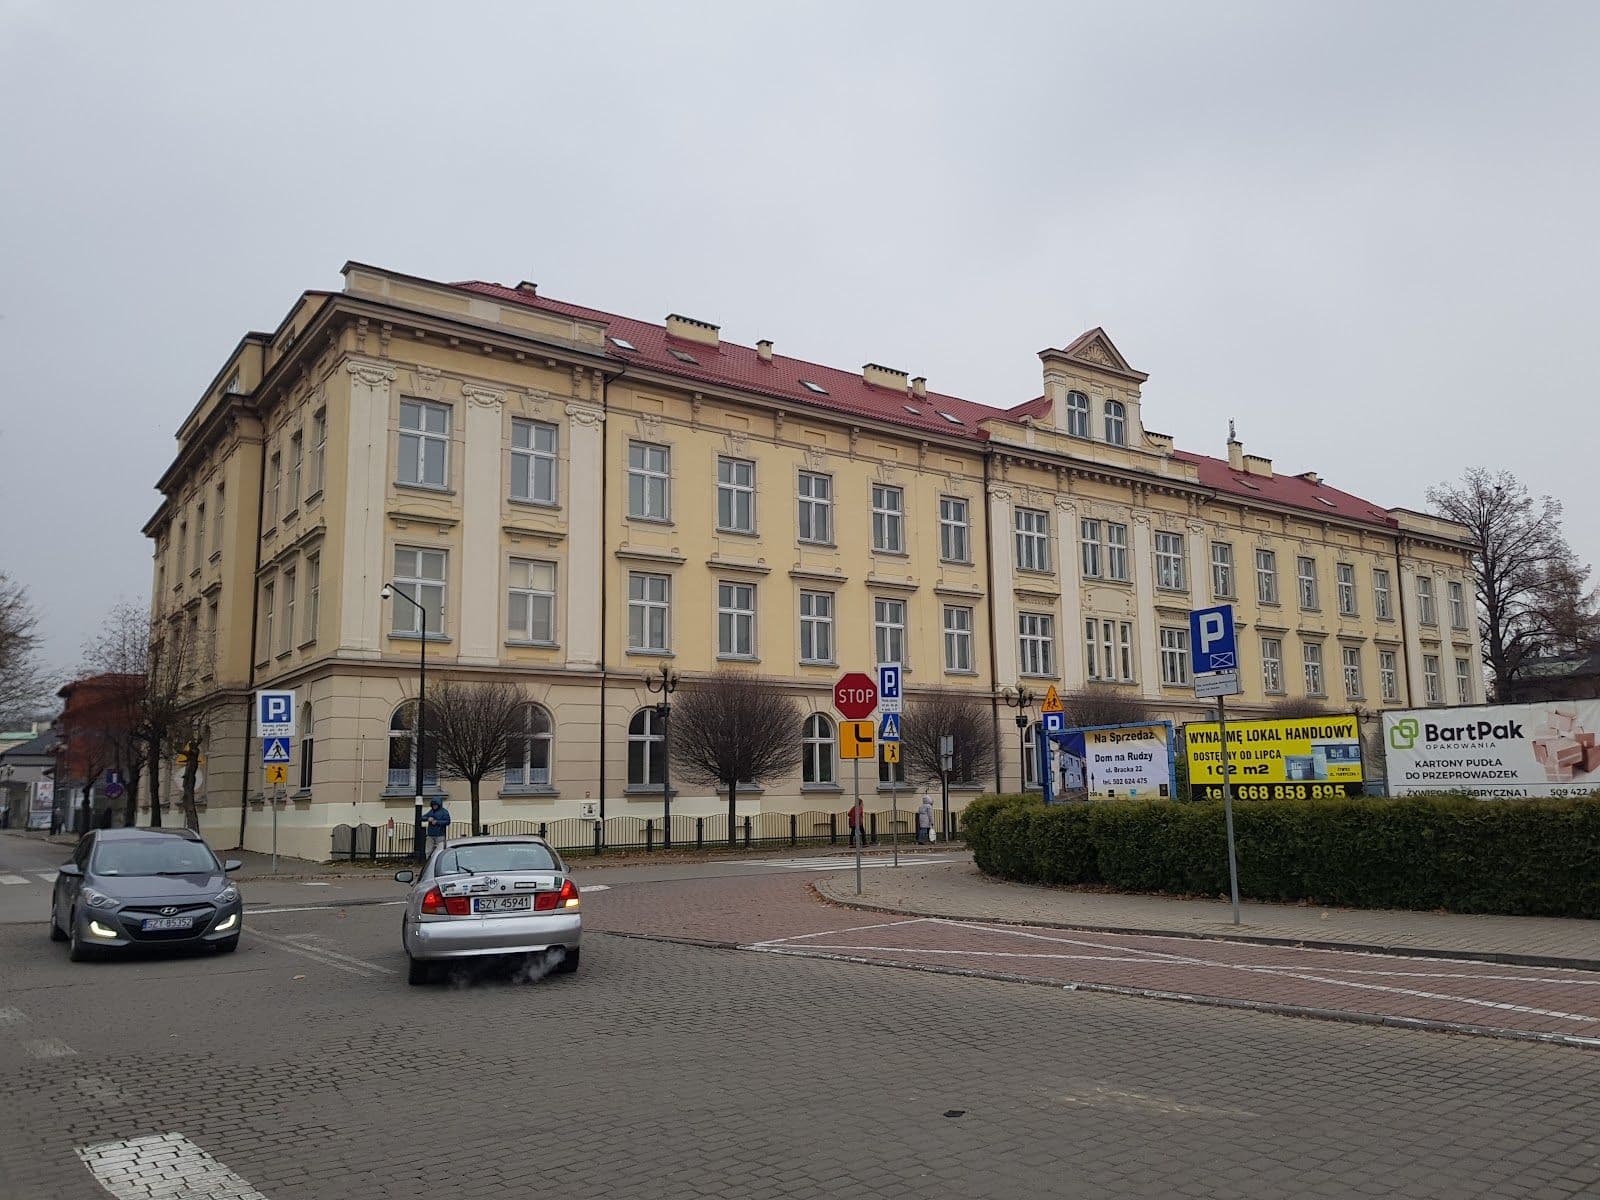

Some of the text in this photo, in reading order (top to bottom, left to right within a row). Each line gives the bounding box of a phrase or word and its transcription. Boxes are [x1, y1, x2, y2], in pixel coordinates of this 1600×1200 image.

[1199, 611, 1225, 654] P
[884, 670, 896, 695] P
[838, 688, 874, 704] STOP
[268, 698, 286, 720] P
[1188, 725, 1353, 744] WYNAMĘ LOKAL HANDLOWY
[1425, 720, 1525, 742] BartPak
[1094, 733, 1107, 744] Na
[1425, 742, 1496, 750] OPAKOWANIA
[1094, 754, 1113, 763] Dom
[1115, 754, 1125, 762] na
[1193, 749, 1282, 762] DOSTĘNY OD LIPCA
[1415, 758, 1503, 768] KARTONY PUDŁA
[1243, 764, 1269, 775] m2
[1405, 770, 1519, 780] DO PRZEPROWADZEK
[1238, 785, 1269, 800] 668
[1274, 785, 1307, 800] 858
[1311, 784, 1346, 799] 895
[1523, 789, 1528, 797] 1
[1570, 788, 1588, 796] 422
[479, 897, 529, 909] SZY 45941
